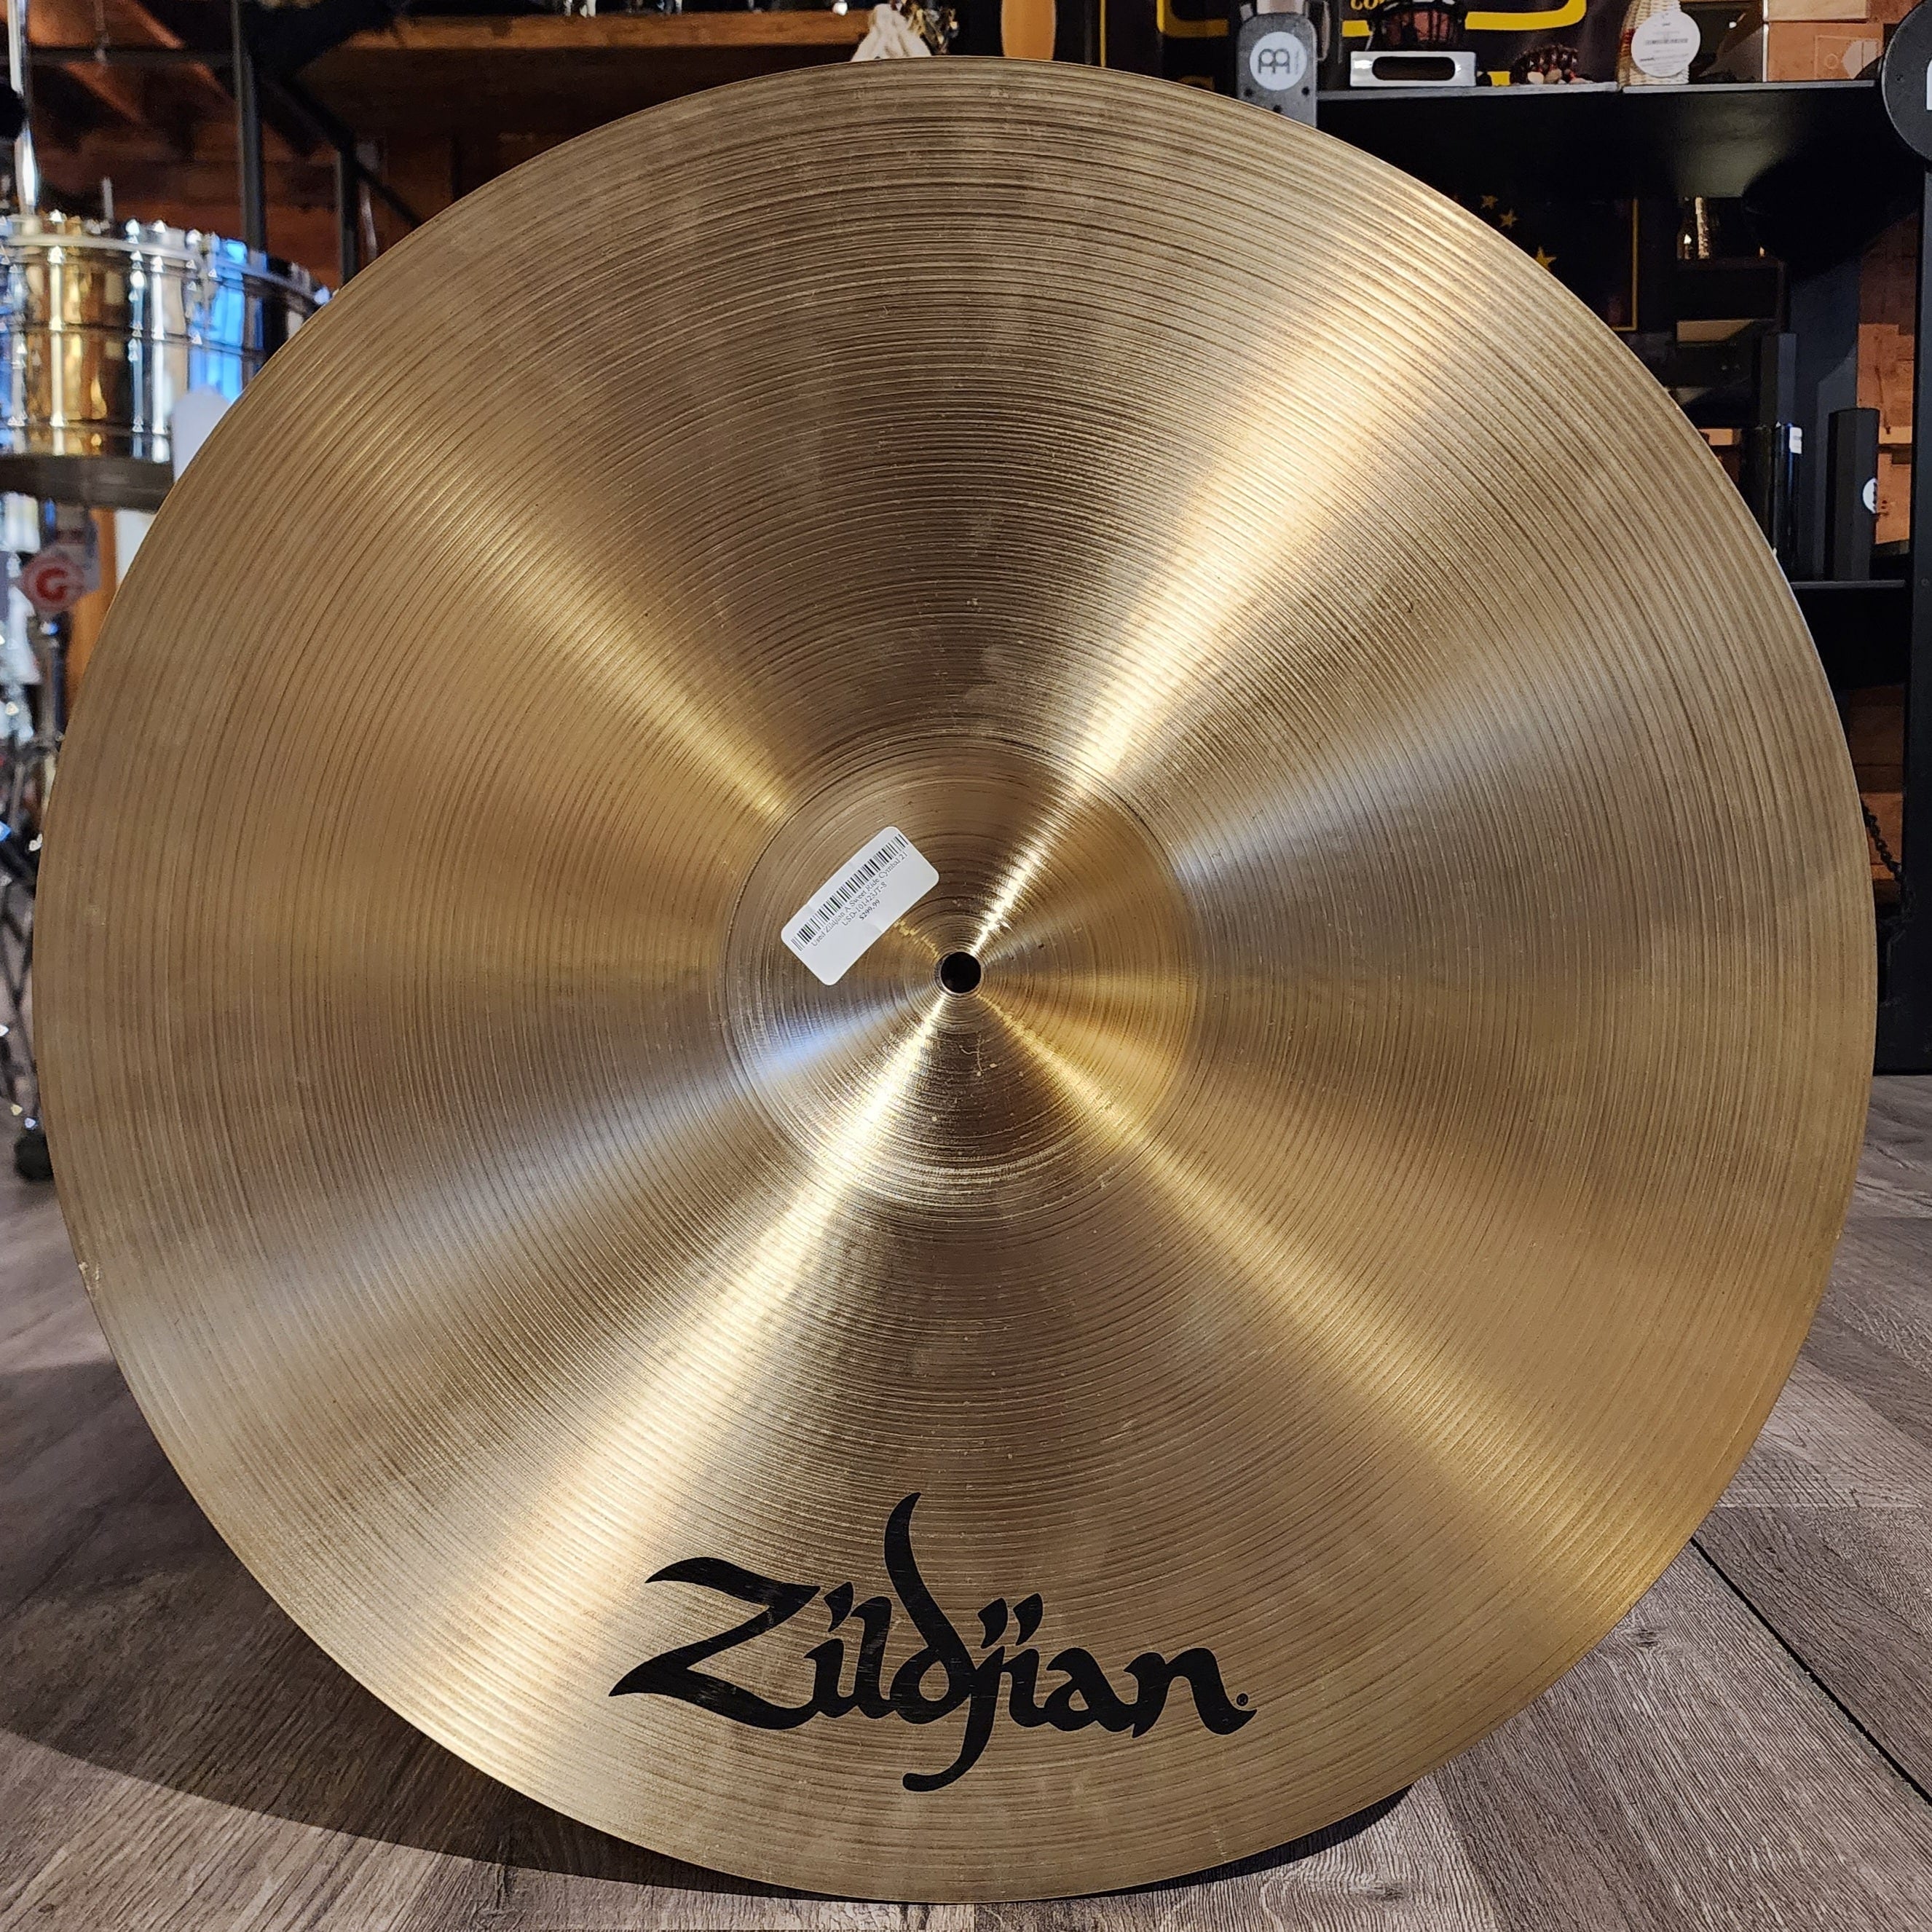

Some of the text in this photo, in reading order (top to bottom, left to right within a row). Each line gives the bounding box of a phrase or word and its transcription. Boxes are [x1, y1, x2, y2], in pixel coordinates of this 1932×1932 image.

[811, 851, 907, 947] Used Zildjian A Sweet Ride Cymbal 21
[858, 898, 881, 920] $299.99
[609, 1492, 1258, 1792] Zildjian
